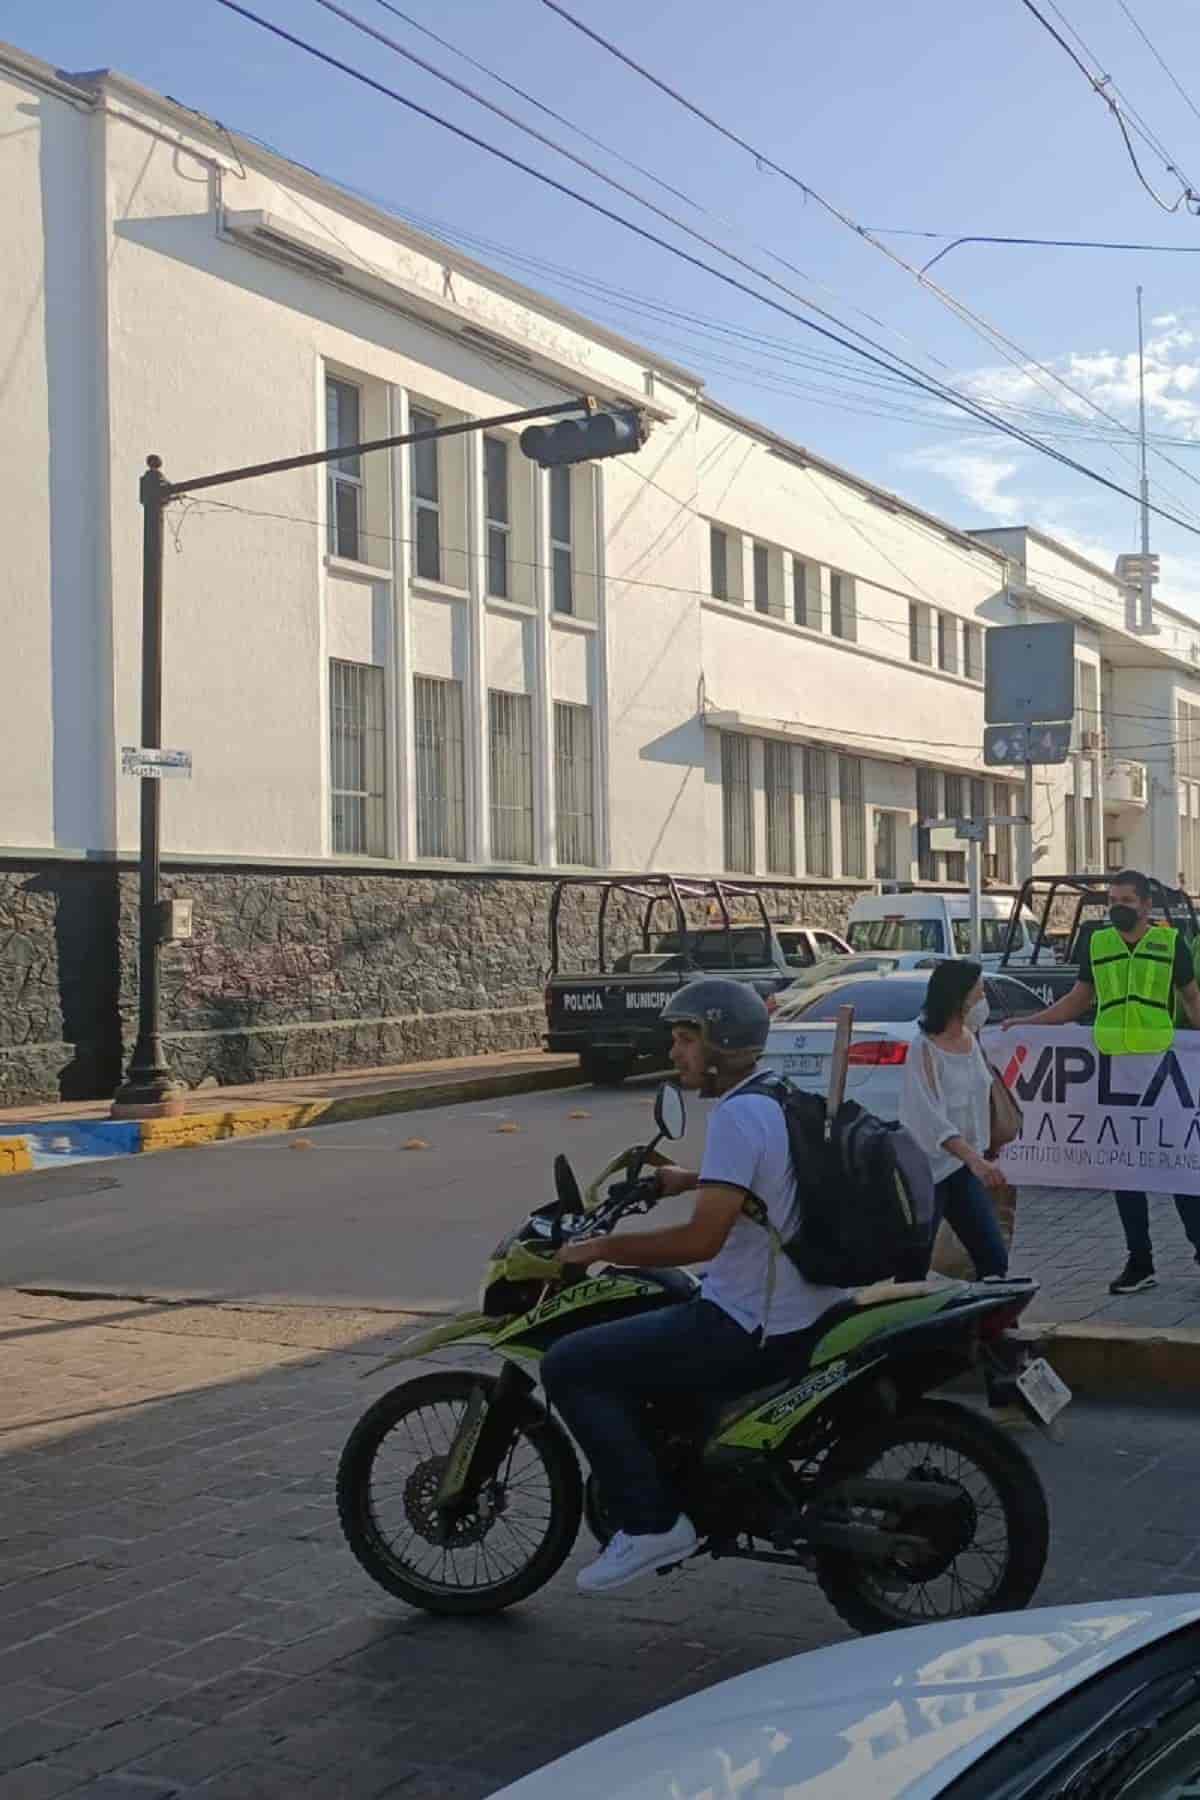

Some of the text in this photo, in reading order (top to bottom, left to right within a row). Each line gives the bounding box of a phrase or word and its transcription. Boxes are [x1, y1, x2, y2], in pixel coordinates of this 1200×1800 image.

[1001, 1144, 1060, 1162] NSTITUTO
[1063, 1146, 1134, 1167] MUNICIPAL
[1139, 1151, 1153, 1168] DE
